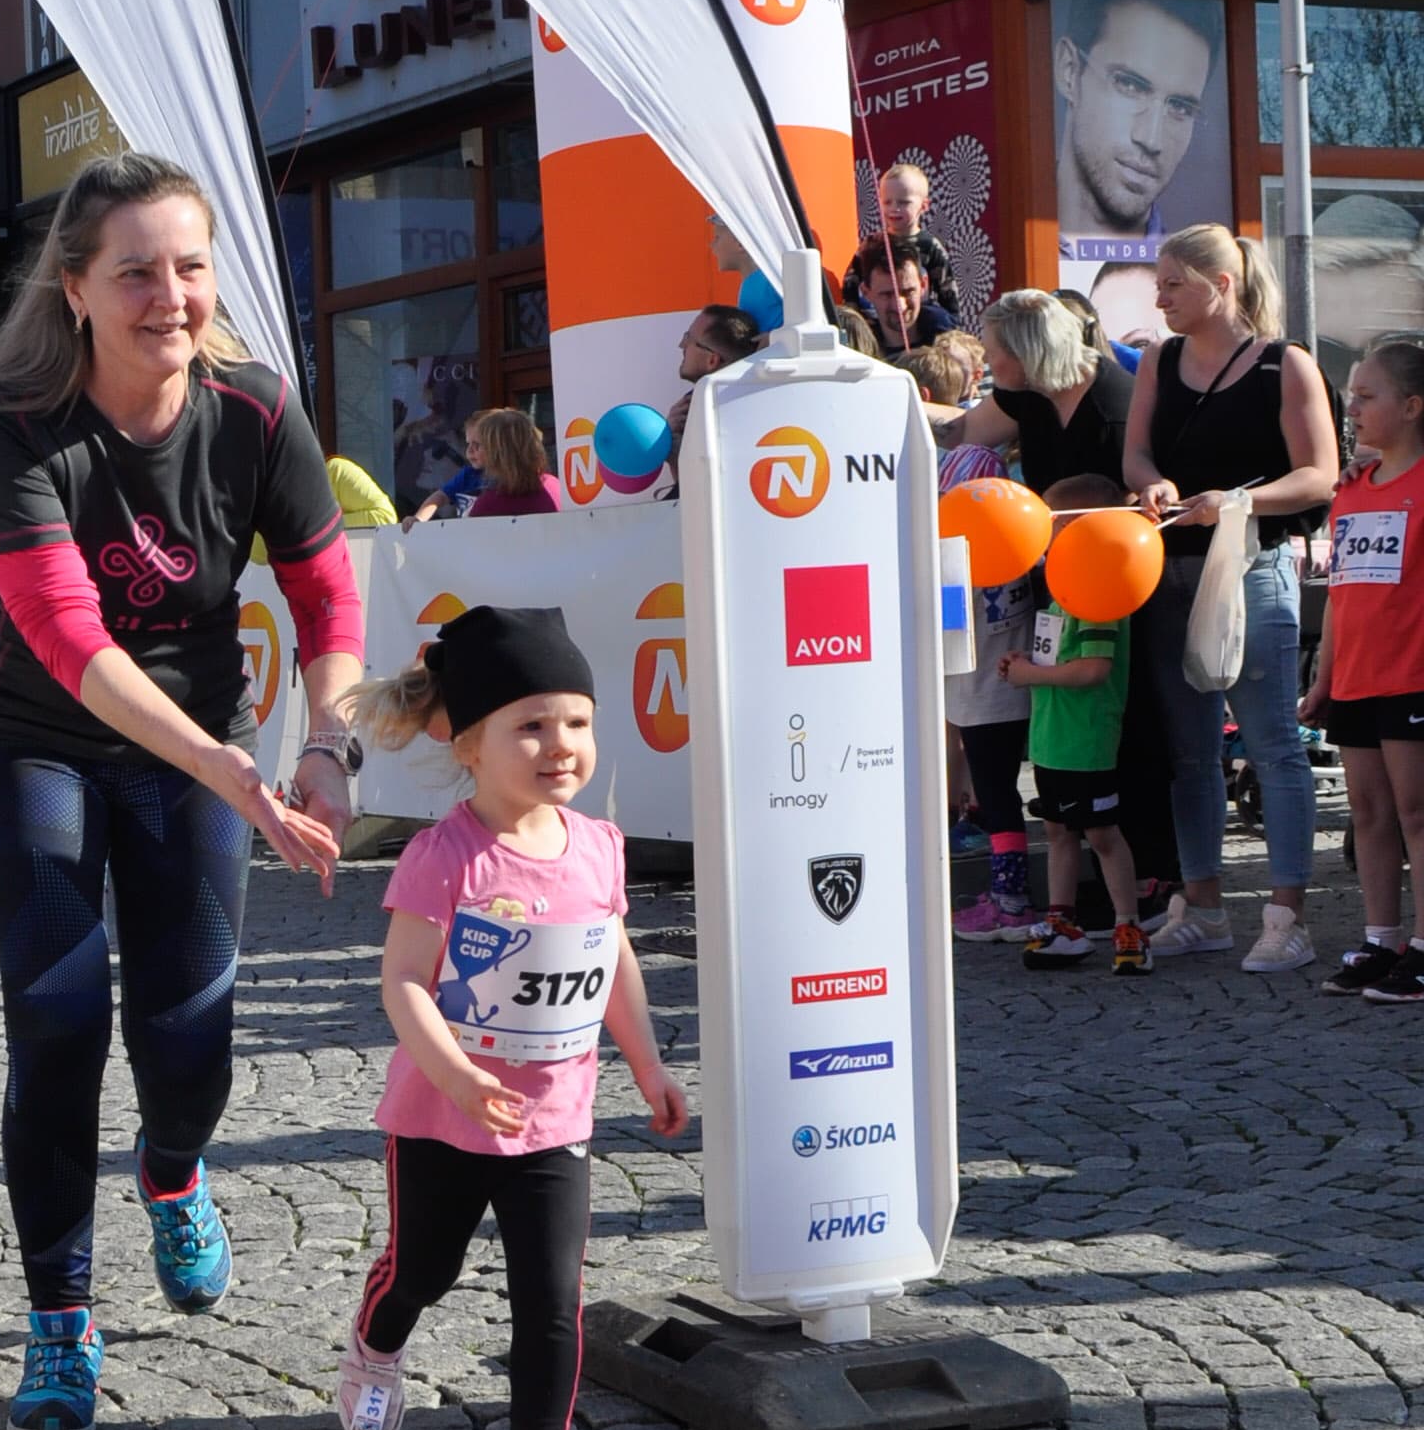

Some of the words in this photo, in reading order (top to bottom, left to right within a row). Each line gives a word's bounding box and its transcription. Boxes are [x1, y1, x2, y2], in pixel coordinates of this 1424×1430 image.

[874, 37, 941, 67] OPTIKA
[844, 452, 896, 483] NN
[1346, 535, 1399, 556] 3042
[794, 635, 862, 658] AVON
[856, 745, 895, 757] Powered
[857, 759, 869, 771] by
[871, 757, 894, 769] MVM
[769, 792, 828, 810] innogy
[812, 859, 860, 871] PEUGEOT
[461, 927, 500, 945] KIDS
[585, 925, 606, 939] KIDS
[459, 942, 494, 960] CUP
[583, 938, 602, 950] CUP
[511, 966, 605, 1007] 3170
[797, 974, 884, 999] NUTREND
[825, 1123, 897, 1150] ŠKODA
[807, 1210, 886, 1242] KPMG
